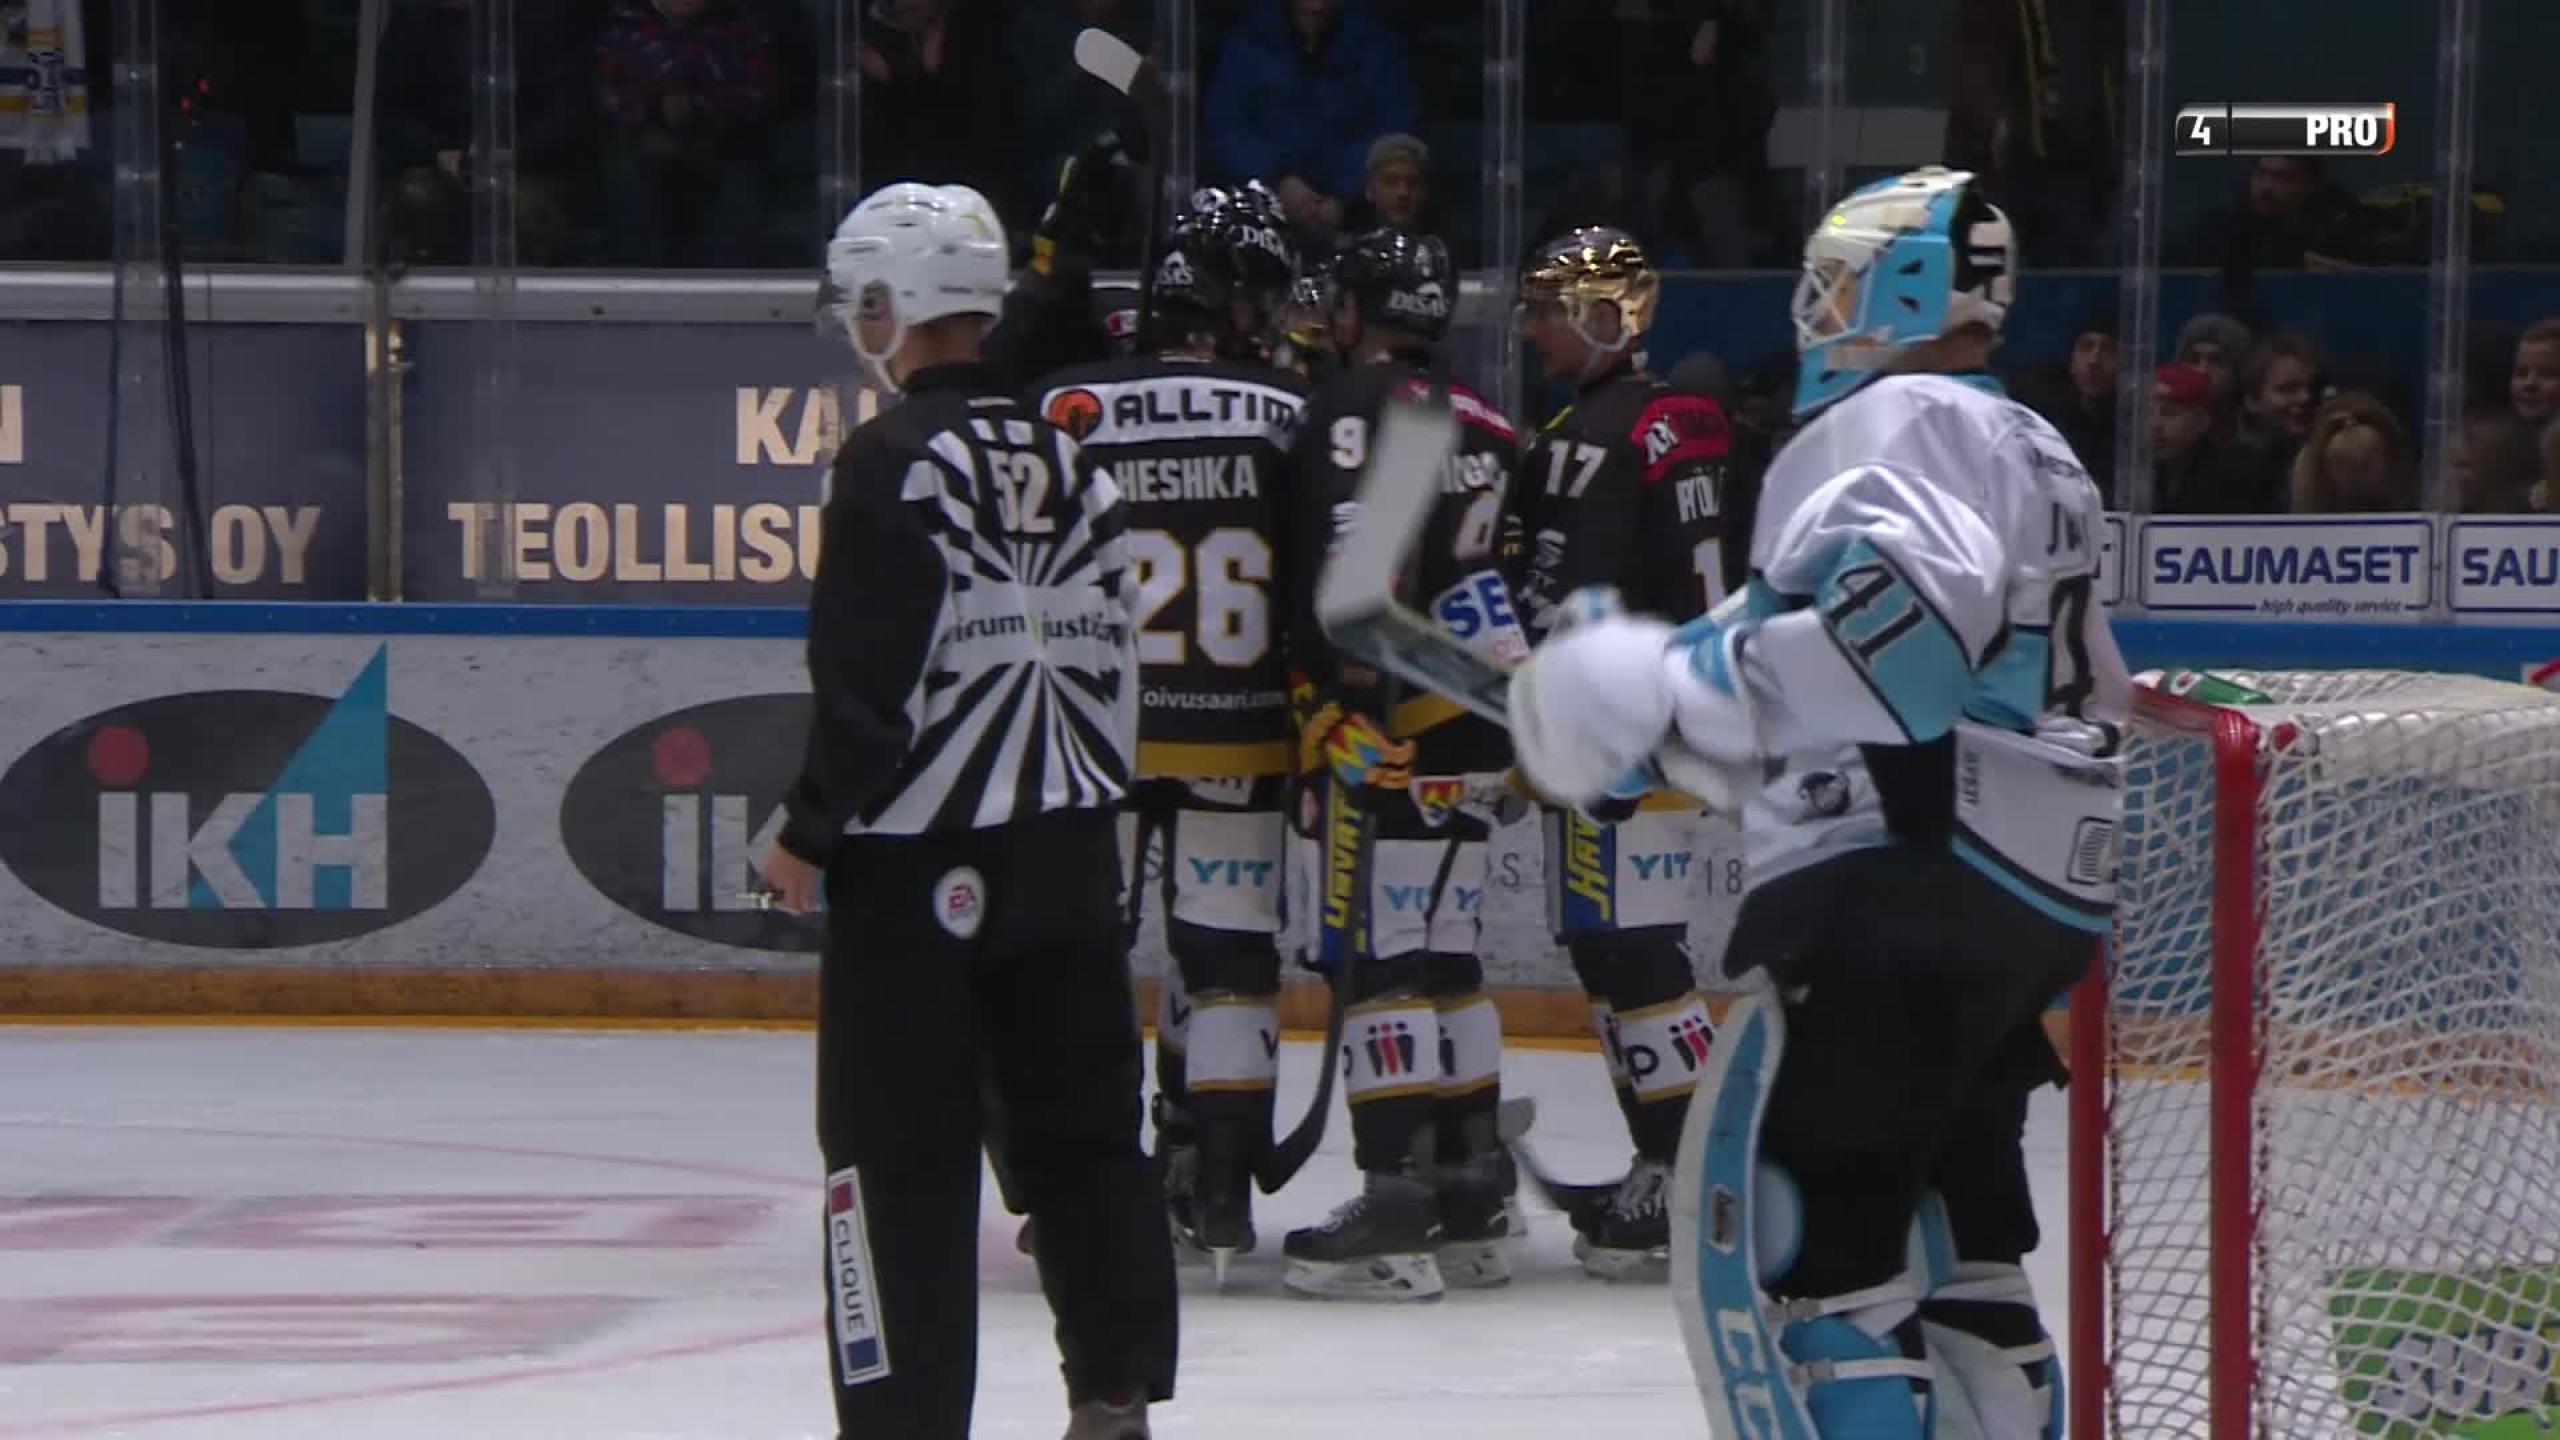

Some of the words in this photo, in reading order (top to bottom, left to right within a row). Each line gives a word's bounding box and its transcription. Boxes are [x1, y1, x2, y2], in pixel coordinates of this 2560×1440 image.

[985, 448, 1056, 533] 52
[1115, 455, 1259, 501] HESHKA
[1546, 439, 1608, 499] 17
[0, 503, 177, 584] TYS
[211, 503, 321, 584] OY
[2153, 545, 2420, 585] SAUMASET
[1135, 526, 1272, 667] 26
[1826, 564, 1924, 666] 41
[1187, 856, 1275, 887] YIT
[1627, 852, 1692, 881] YIT
[834, 1219, 866, 1334] CLIQUE
